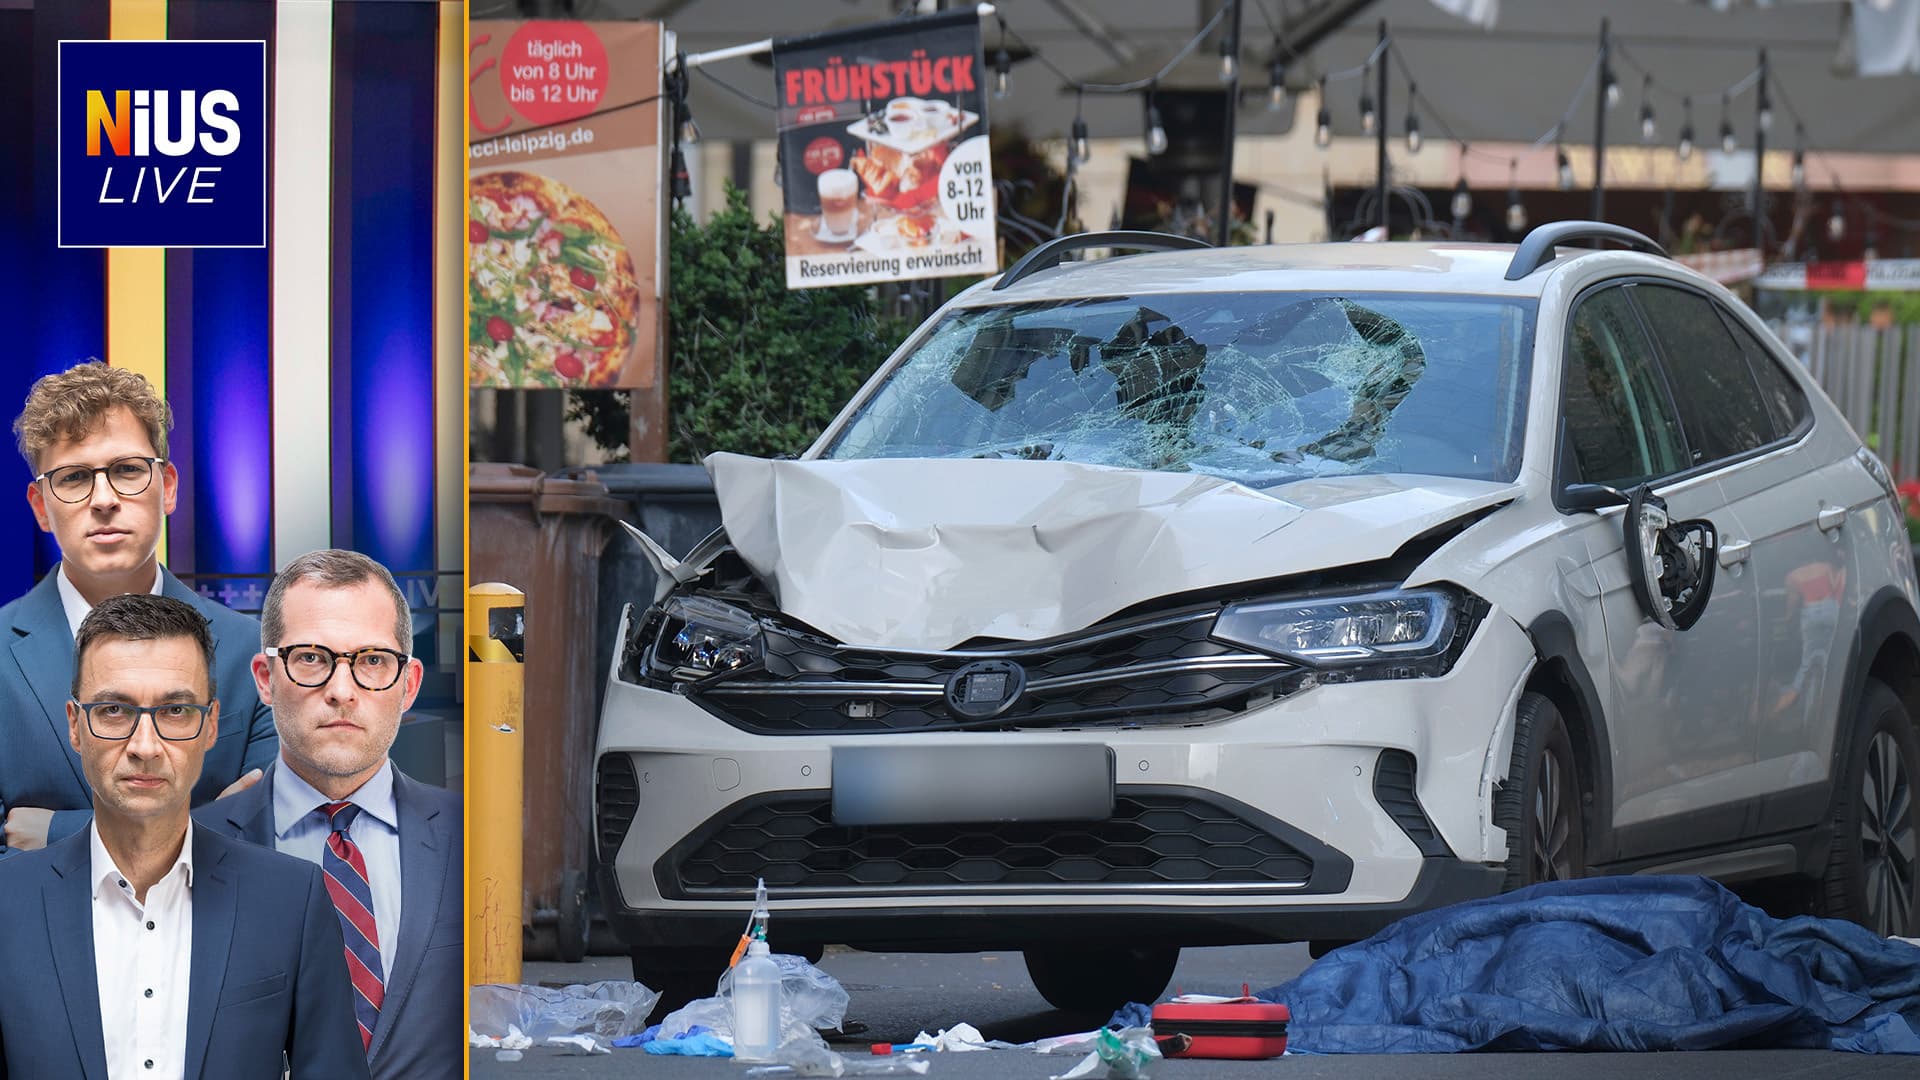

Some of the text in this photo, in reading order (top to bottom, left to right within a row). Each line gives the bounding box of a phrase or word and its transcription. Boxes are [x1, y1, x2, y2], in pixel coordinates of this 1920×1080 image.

[527, 39, 582, 61] täglich
[513, 62, 596, 80] von 8 Uhr
[785, 49, 976, 106] FRÜHSTÜCK
[510, 84, 598, 102] bis 12 Uhr
[954, 160, 983, 175] von
[947, 180, 984, 199] 8-12
[957, 202, 985, 221] Uhr
[800, 247, 983, 278] Reservierung erwünscht
